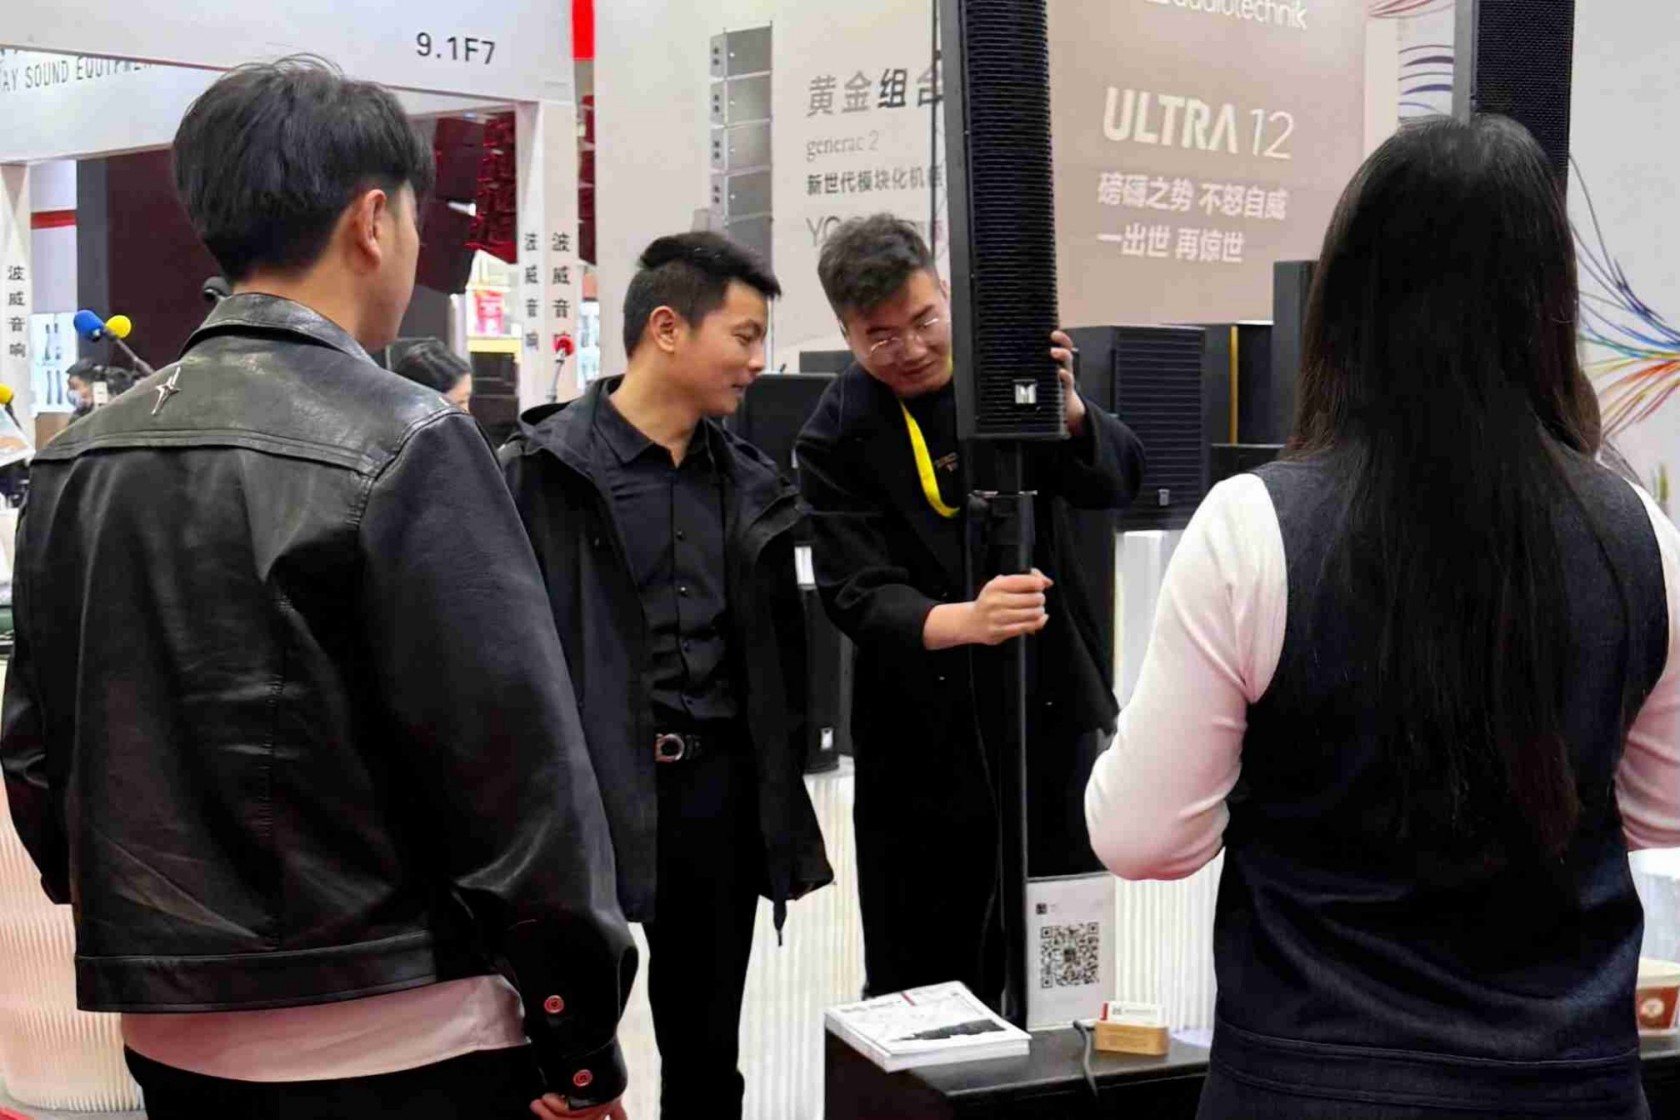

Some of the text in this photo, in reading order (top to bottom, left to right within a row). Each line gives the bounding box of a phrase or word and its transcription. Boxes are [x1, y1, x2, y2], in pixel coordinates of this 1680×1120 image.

[416, 31, 496, 65] 9.1F7
[25, 60, 70, 89] SOUND
[76, 55, 153, 81] EQUIP
[868, 129, 880, 152] 2
[1103, 85, 1295, 159] ULTRA 12
[1198, 182, 1290, 221] 不怒自威
[1096, 222, 1245, 263] 一出世 再惊世
[552, 231, 571, 341] 波威音
[7, 264, 27, 359] 波威音响
